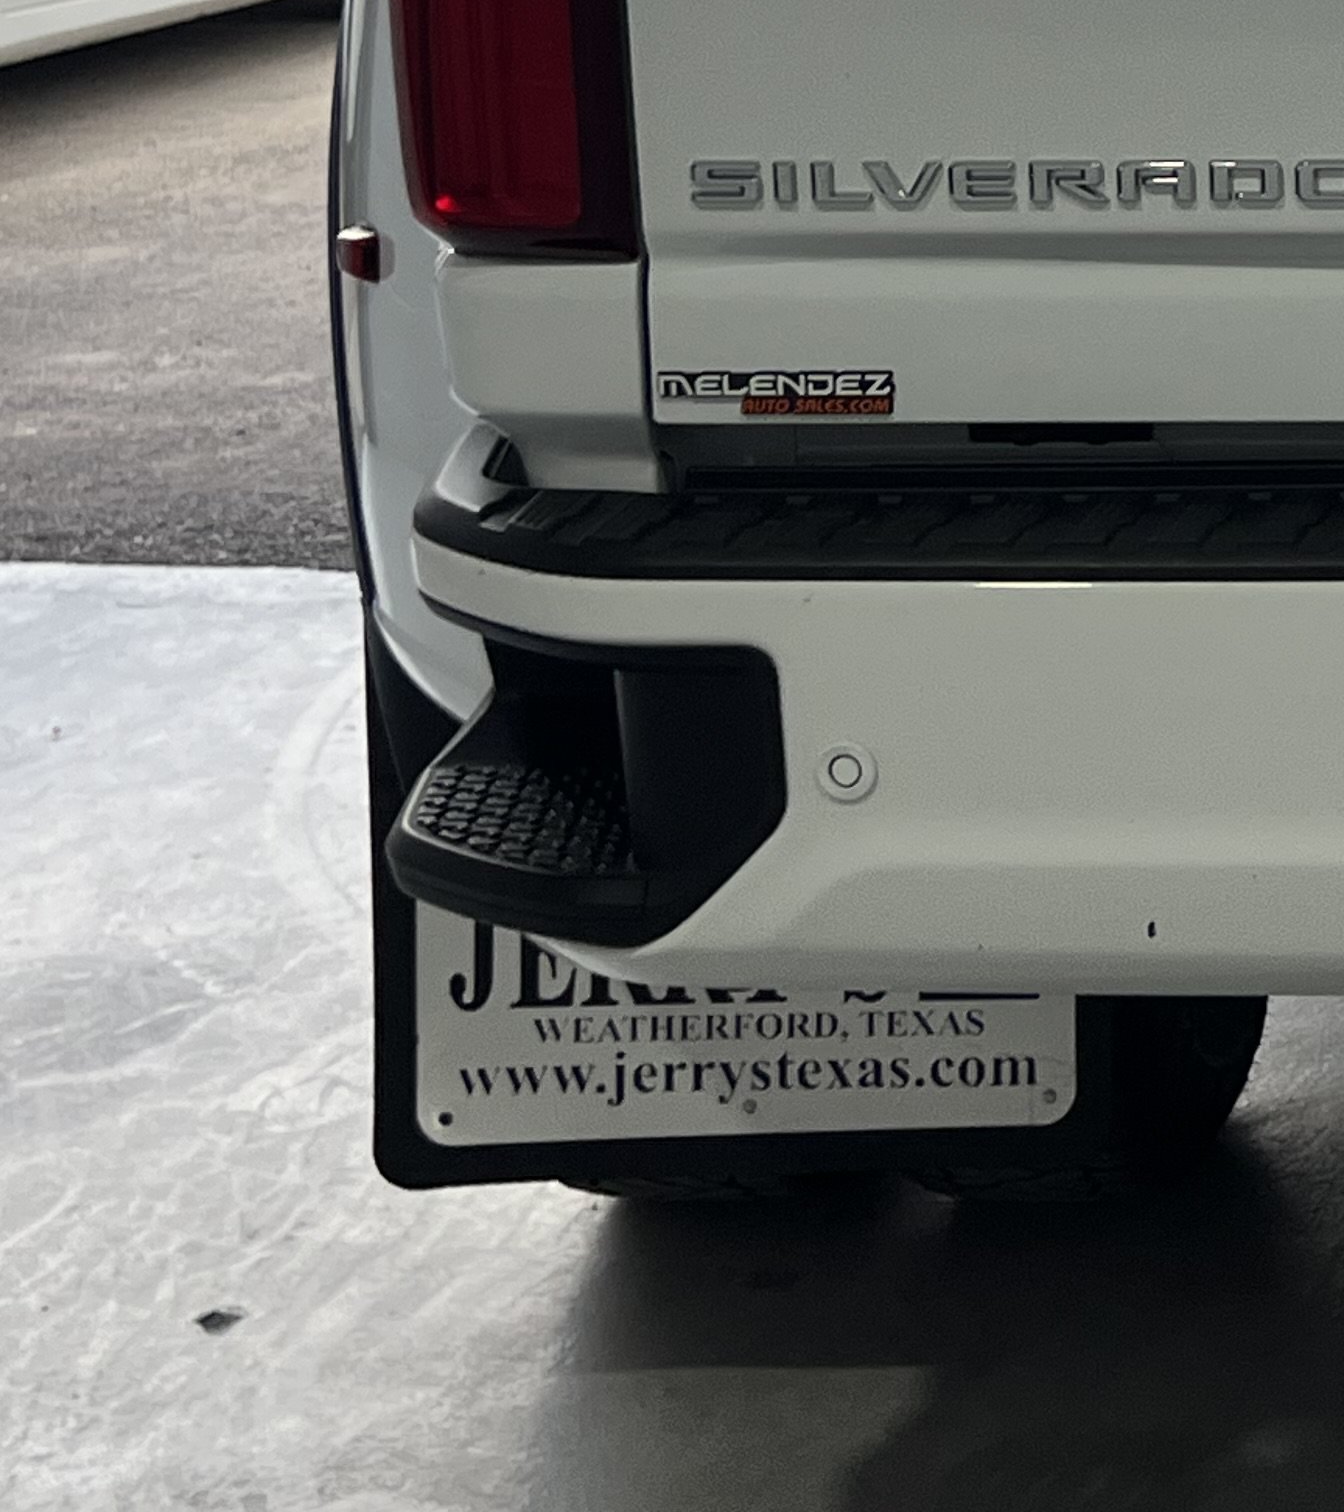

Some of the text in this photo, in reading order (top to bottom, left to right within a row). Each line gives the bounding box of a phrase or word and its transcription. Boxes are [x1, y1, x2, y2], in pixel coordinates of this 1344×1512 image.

[660, 373, 892, 397] MELENDEZ
[742, 397, 891, 414] AUTO SALES.COM
[533, 1009, 986, 1044] WEATHERFORD, TEXAS
[458, 1050, 1039, 1107] www.jerrystexas.com
